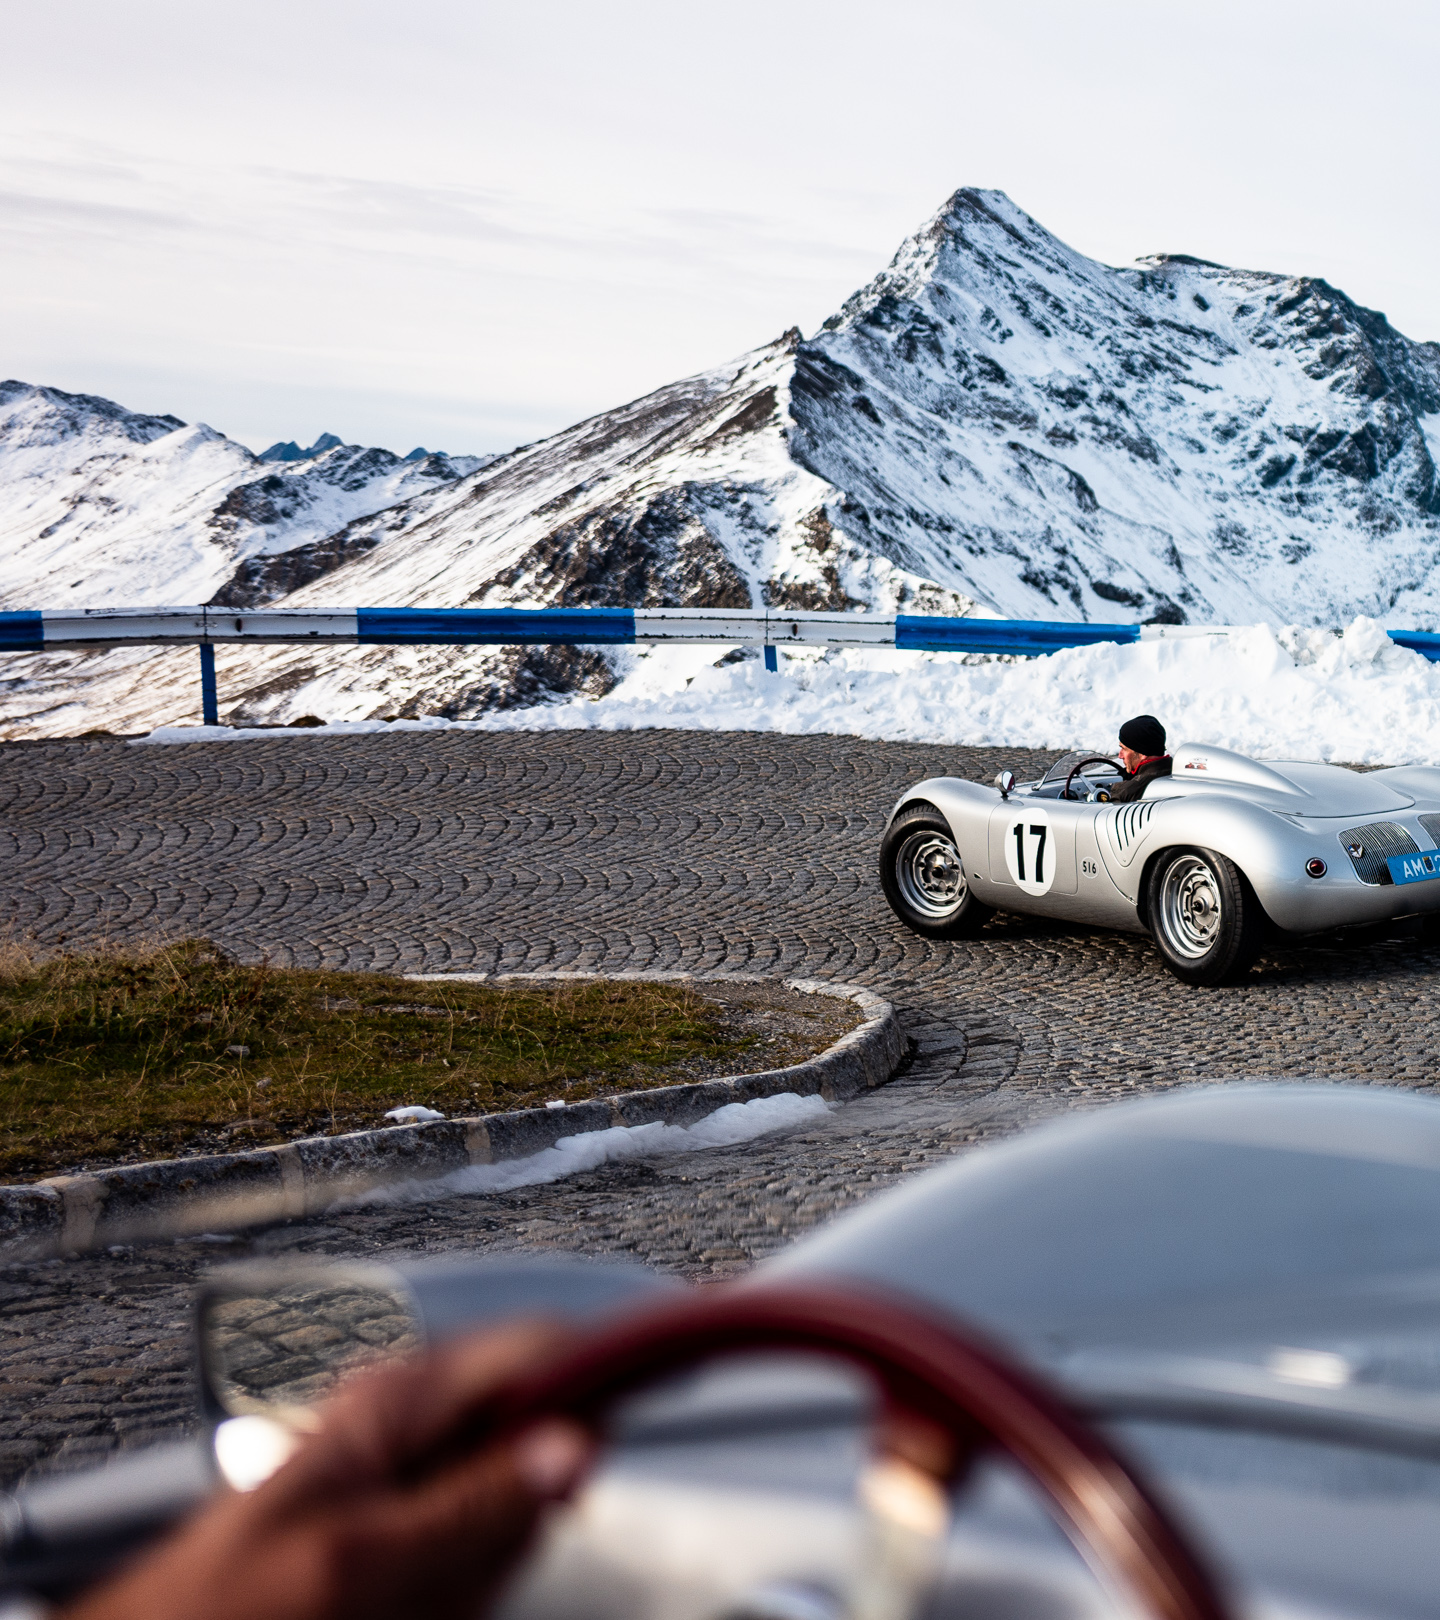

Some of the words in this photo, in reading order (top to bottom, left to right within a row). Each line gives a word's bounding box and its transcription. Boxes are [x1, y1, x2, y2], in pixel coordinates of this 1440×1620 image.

[1013, 823, 1047, 883] 17
[1082, 861, 1097, 874] 516
[1403, 857, 1426, 878] AM
